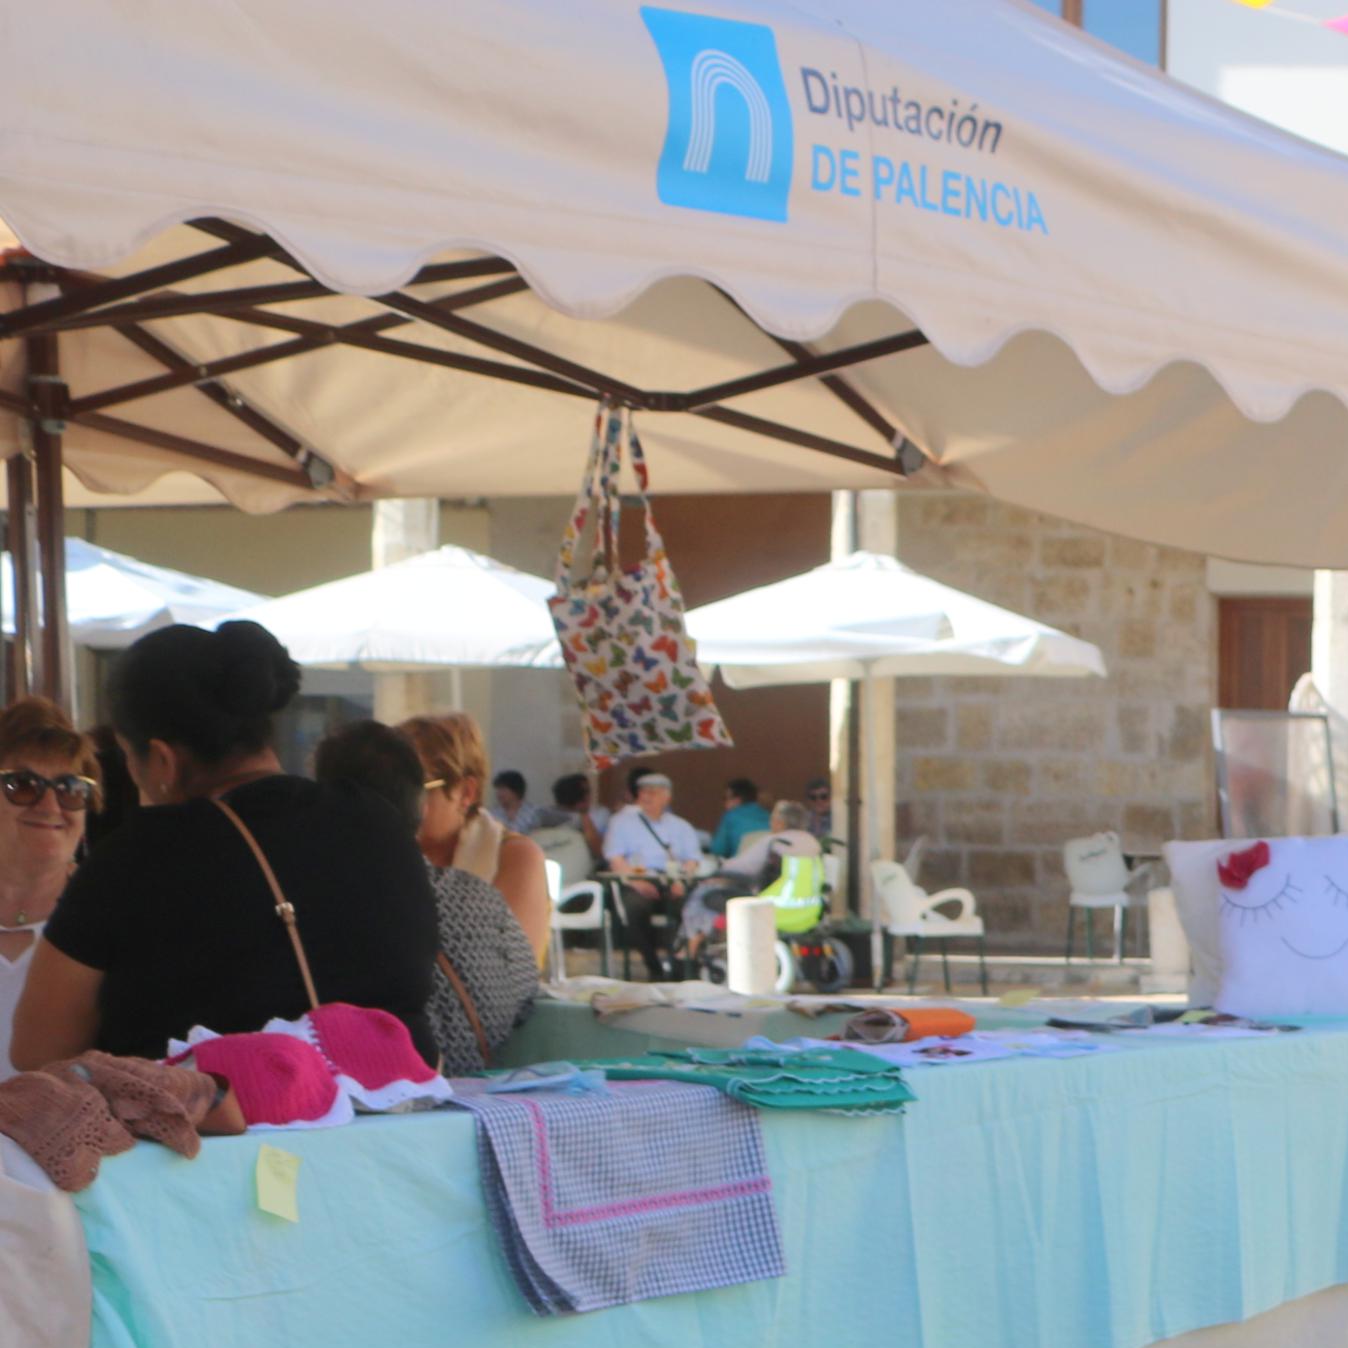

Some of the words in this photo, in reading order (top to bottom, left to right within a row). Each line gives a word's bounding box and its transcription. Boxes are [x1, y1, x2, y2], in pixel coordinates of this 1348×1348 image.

[801, 68, 1003, 153] Diputación
[812, 144, 862, 196] DE
[873, 156, 1050, 235] PALENCIA
